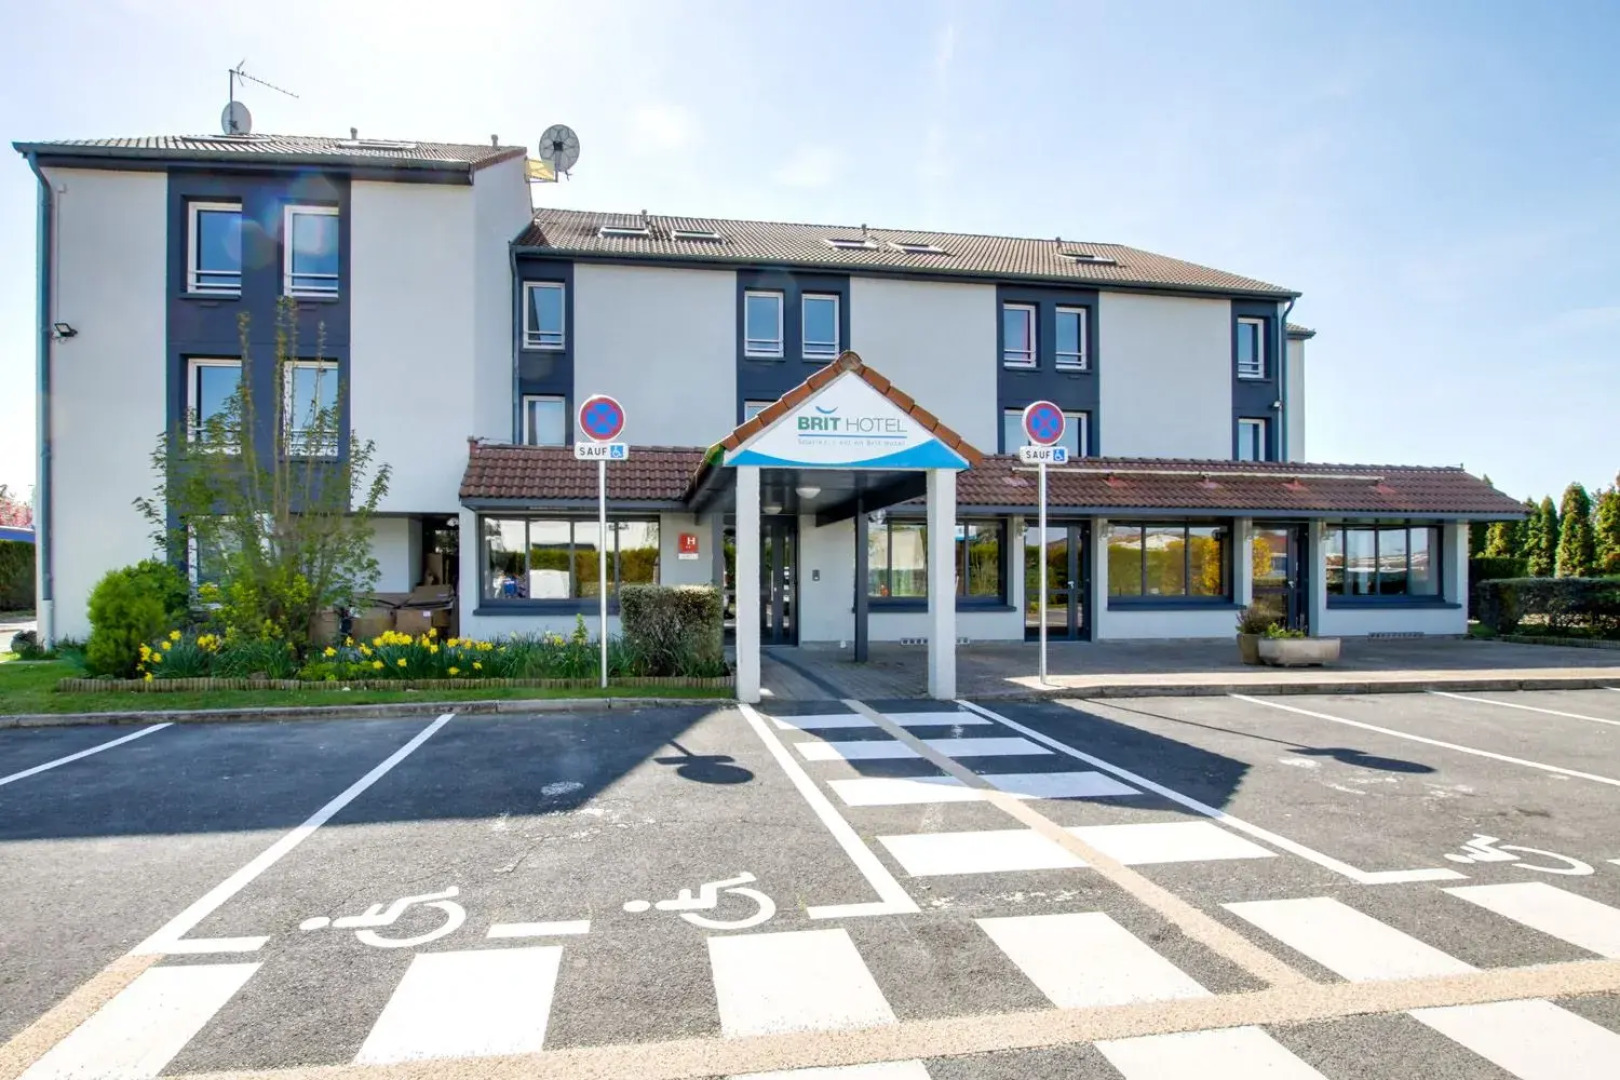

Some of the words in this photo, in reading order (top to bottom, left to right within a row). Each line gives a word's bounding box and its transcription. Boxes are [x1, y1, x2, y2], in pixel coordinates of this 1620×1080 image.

[798, 416, 841, 431] BRIT
[846, 417, 907, 432] HOTEL
[579, 446, 608, 456] SAUF
[1025, 450, 1051, 459] SAUF
[687, 536, 696, 545] H
